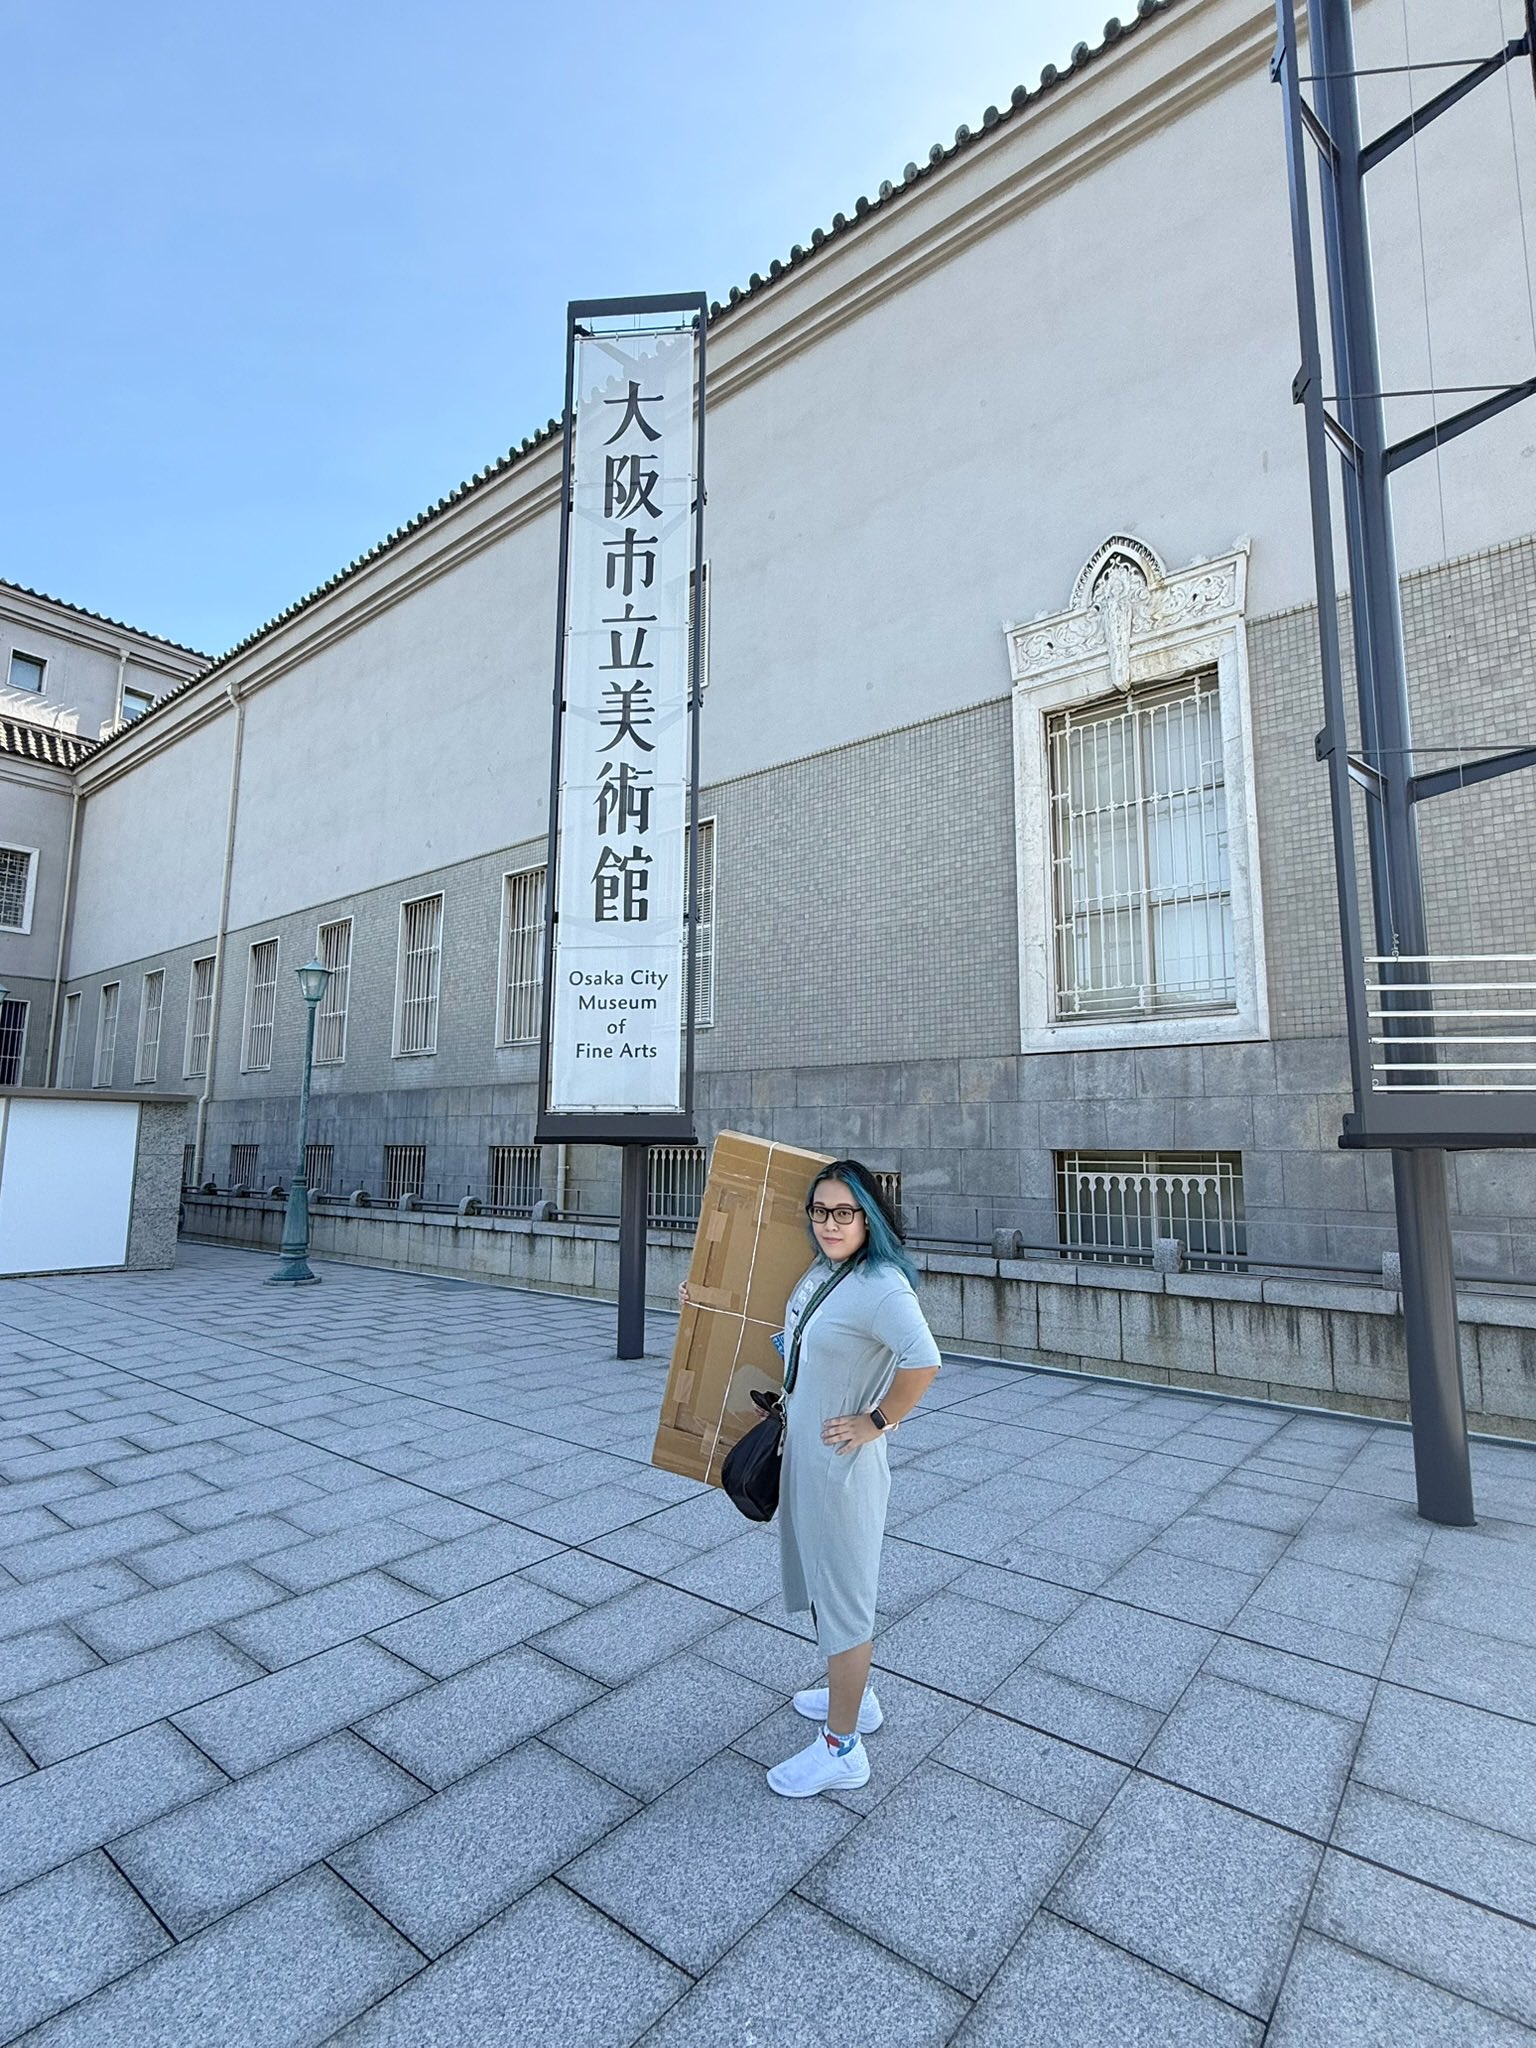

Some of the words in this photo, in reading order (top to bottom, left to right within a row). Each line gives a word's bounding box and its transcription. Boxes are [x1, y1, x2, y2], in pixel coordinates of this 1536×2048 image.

[591, 380, 664, 922] 大阪市立美術館
[569, 970, 624, 986] Osaka
[631, 969, 669, 990] City
[579, 995, 657, 1010] Museum
[607, 1018, 626, 1034] of
[576, 1043, 613, 1058] Fine
[620, 1042, 657, 1058] Arts
